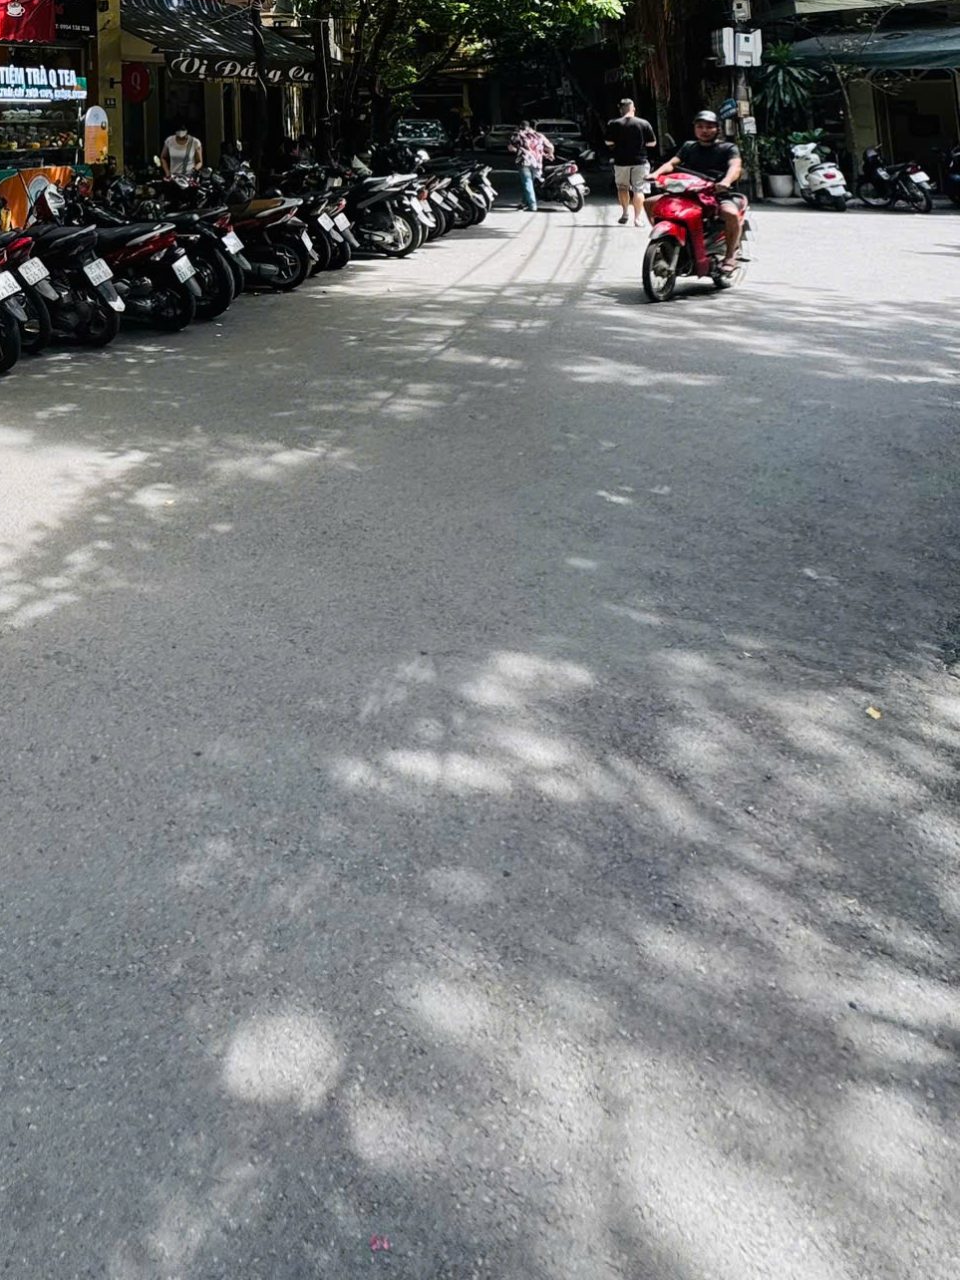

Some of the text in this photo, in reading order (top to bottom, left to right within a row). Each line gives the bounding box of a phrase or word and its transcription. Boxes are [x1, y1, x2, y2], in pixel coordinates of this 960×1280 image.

[25, 65, 48, 86] TRÀ
[48, 68, 58, 88] Q
[57, 68, 77, 86] TEA
[170, 57, 208, 79] Vị
[131, 71, 142, 90] Q
